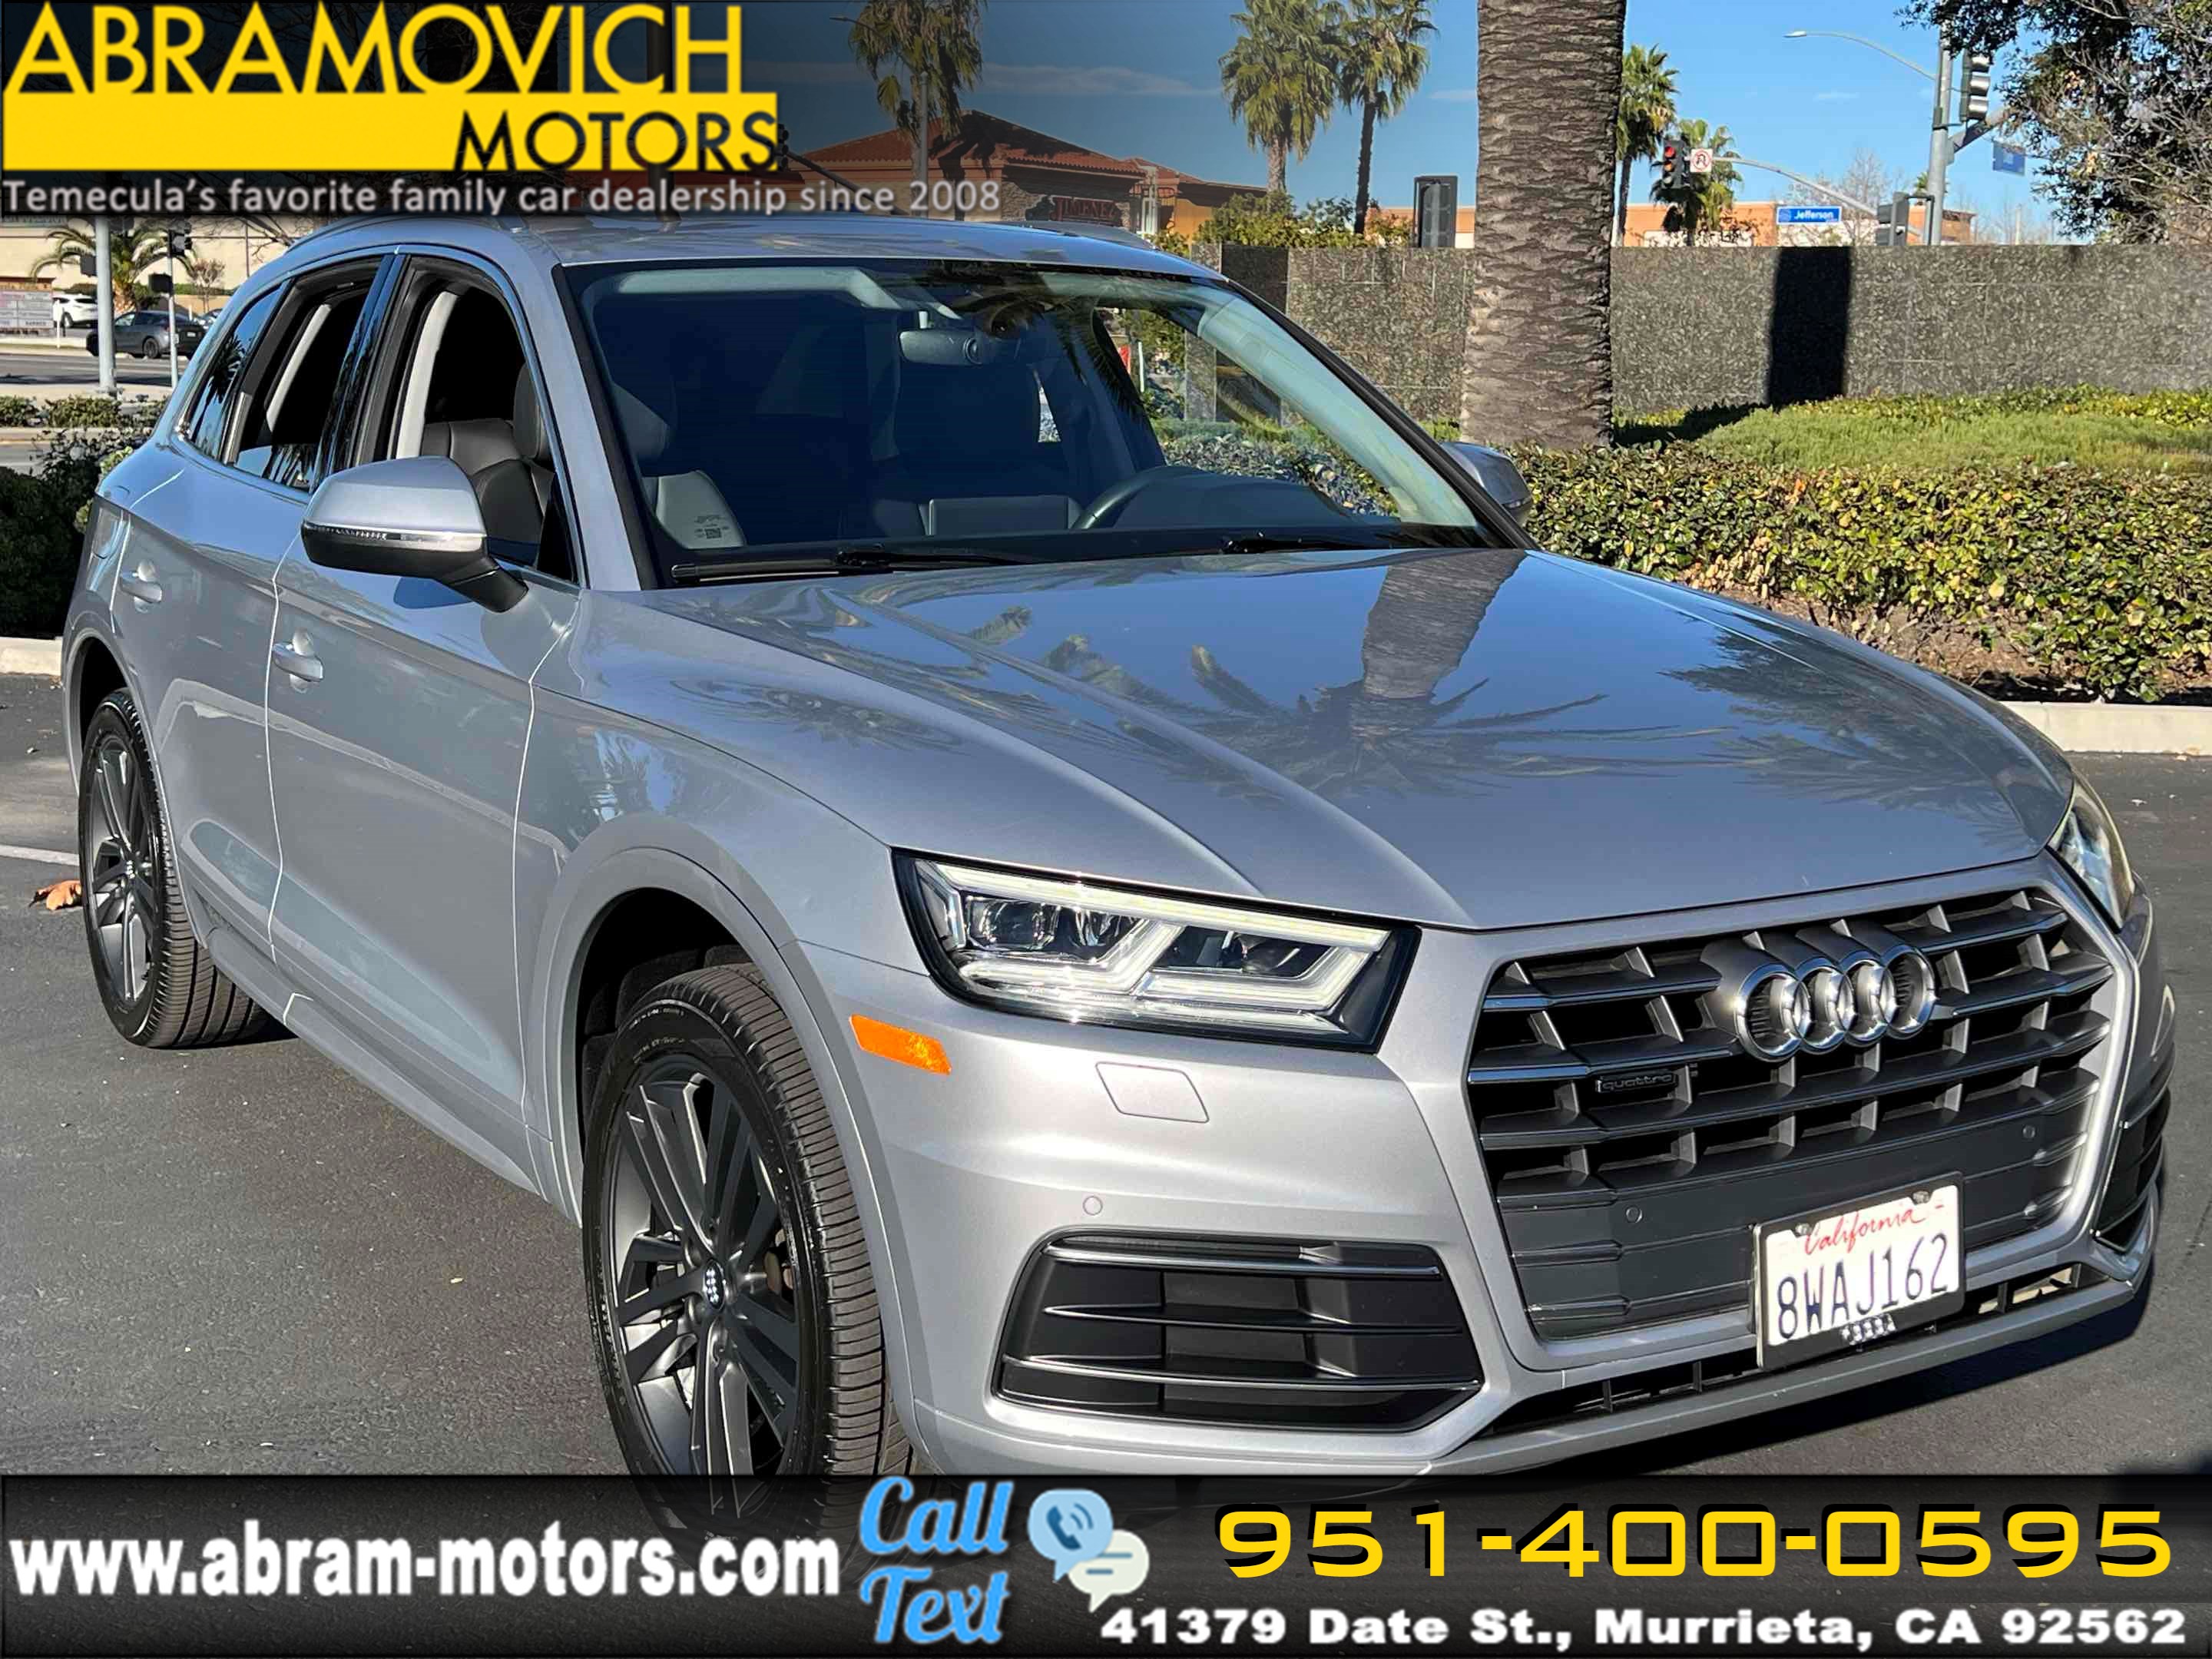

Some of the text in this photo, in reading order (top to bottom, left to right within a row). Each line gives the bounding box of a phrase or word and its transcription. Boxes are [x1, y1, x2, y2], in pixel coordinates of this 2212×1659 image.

[1793, 209, 1834, 220] Jefferson
[1602, 1075, 1671, 1091] quattro
[1804, 1208, 1926, 1256] California
[1777, 1232, 1949, 1339] 8WAJ162
